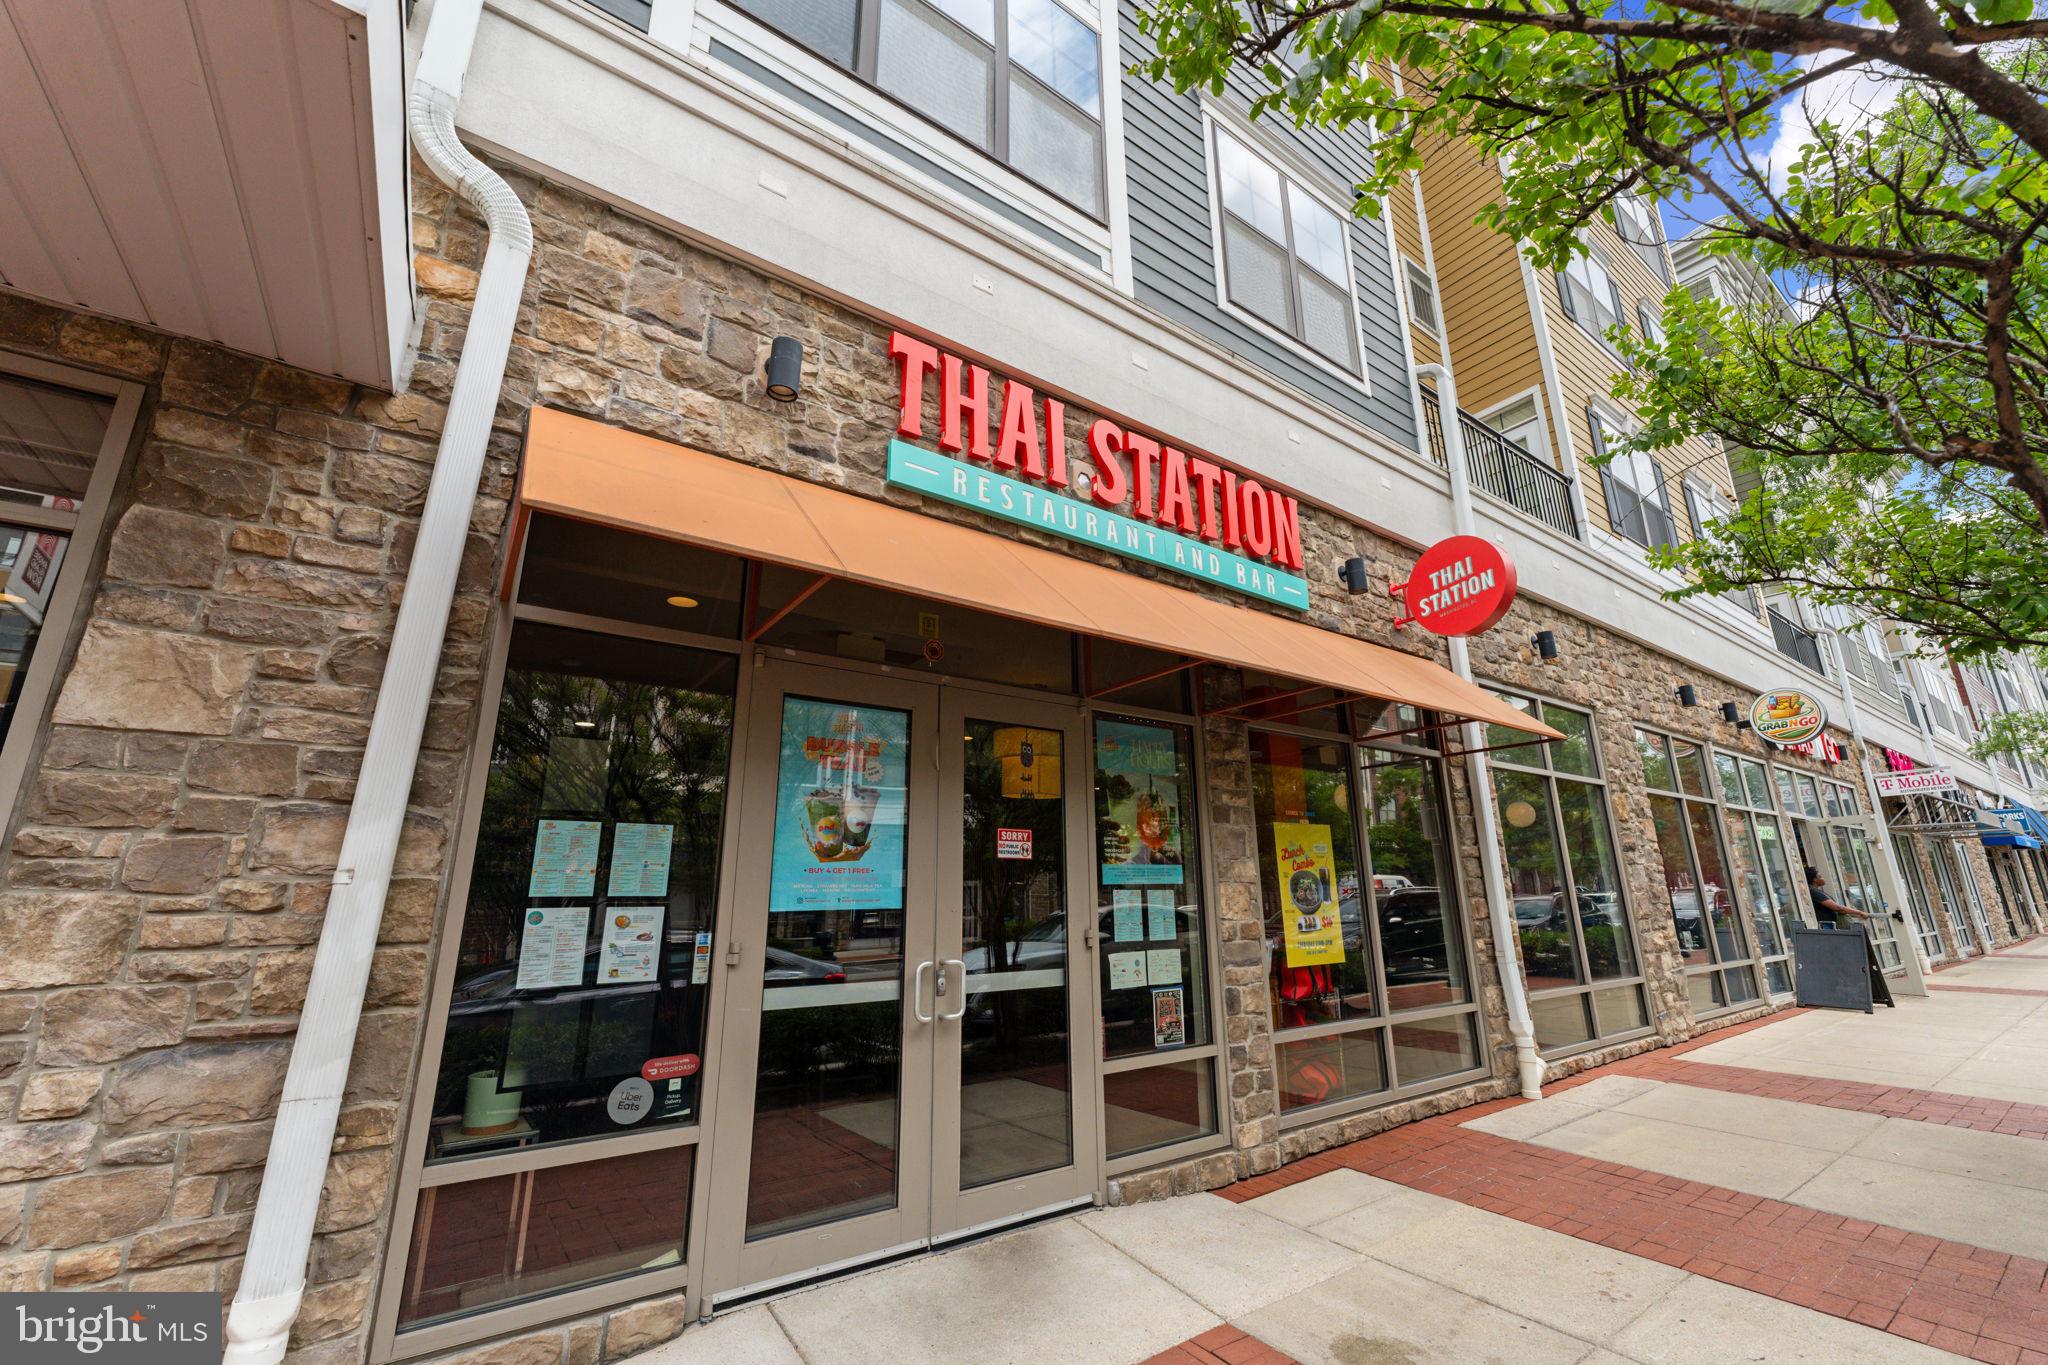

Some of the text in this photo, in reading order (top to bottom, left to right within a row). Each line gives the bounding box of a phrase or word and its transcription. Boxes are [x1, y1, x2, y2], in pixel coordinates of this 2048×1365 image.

[888, 331, 1304, 571] THAI STATION
[953, 466, 1277, 596] RESTAURANT AND BAR
[1429, 556, 1473, 590] THAI
[1420, 569, 1496, 617] STATION
[1001, 831, 1028, 841] SORRY
[659, 1064, 696, 1074] DOORDASH
[617, 1101, 640, 1111] Eats
[621, 1091, 643, 1101] Uber
